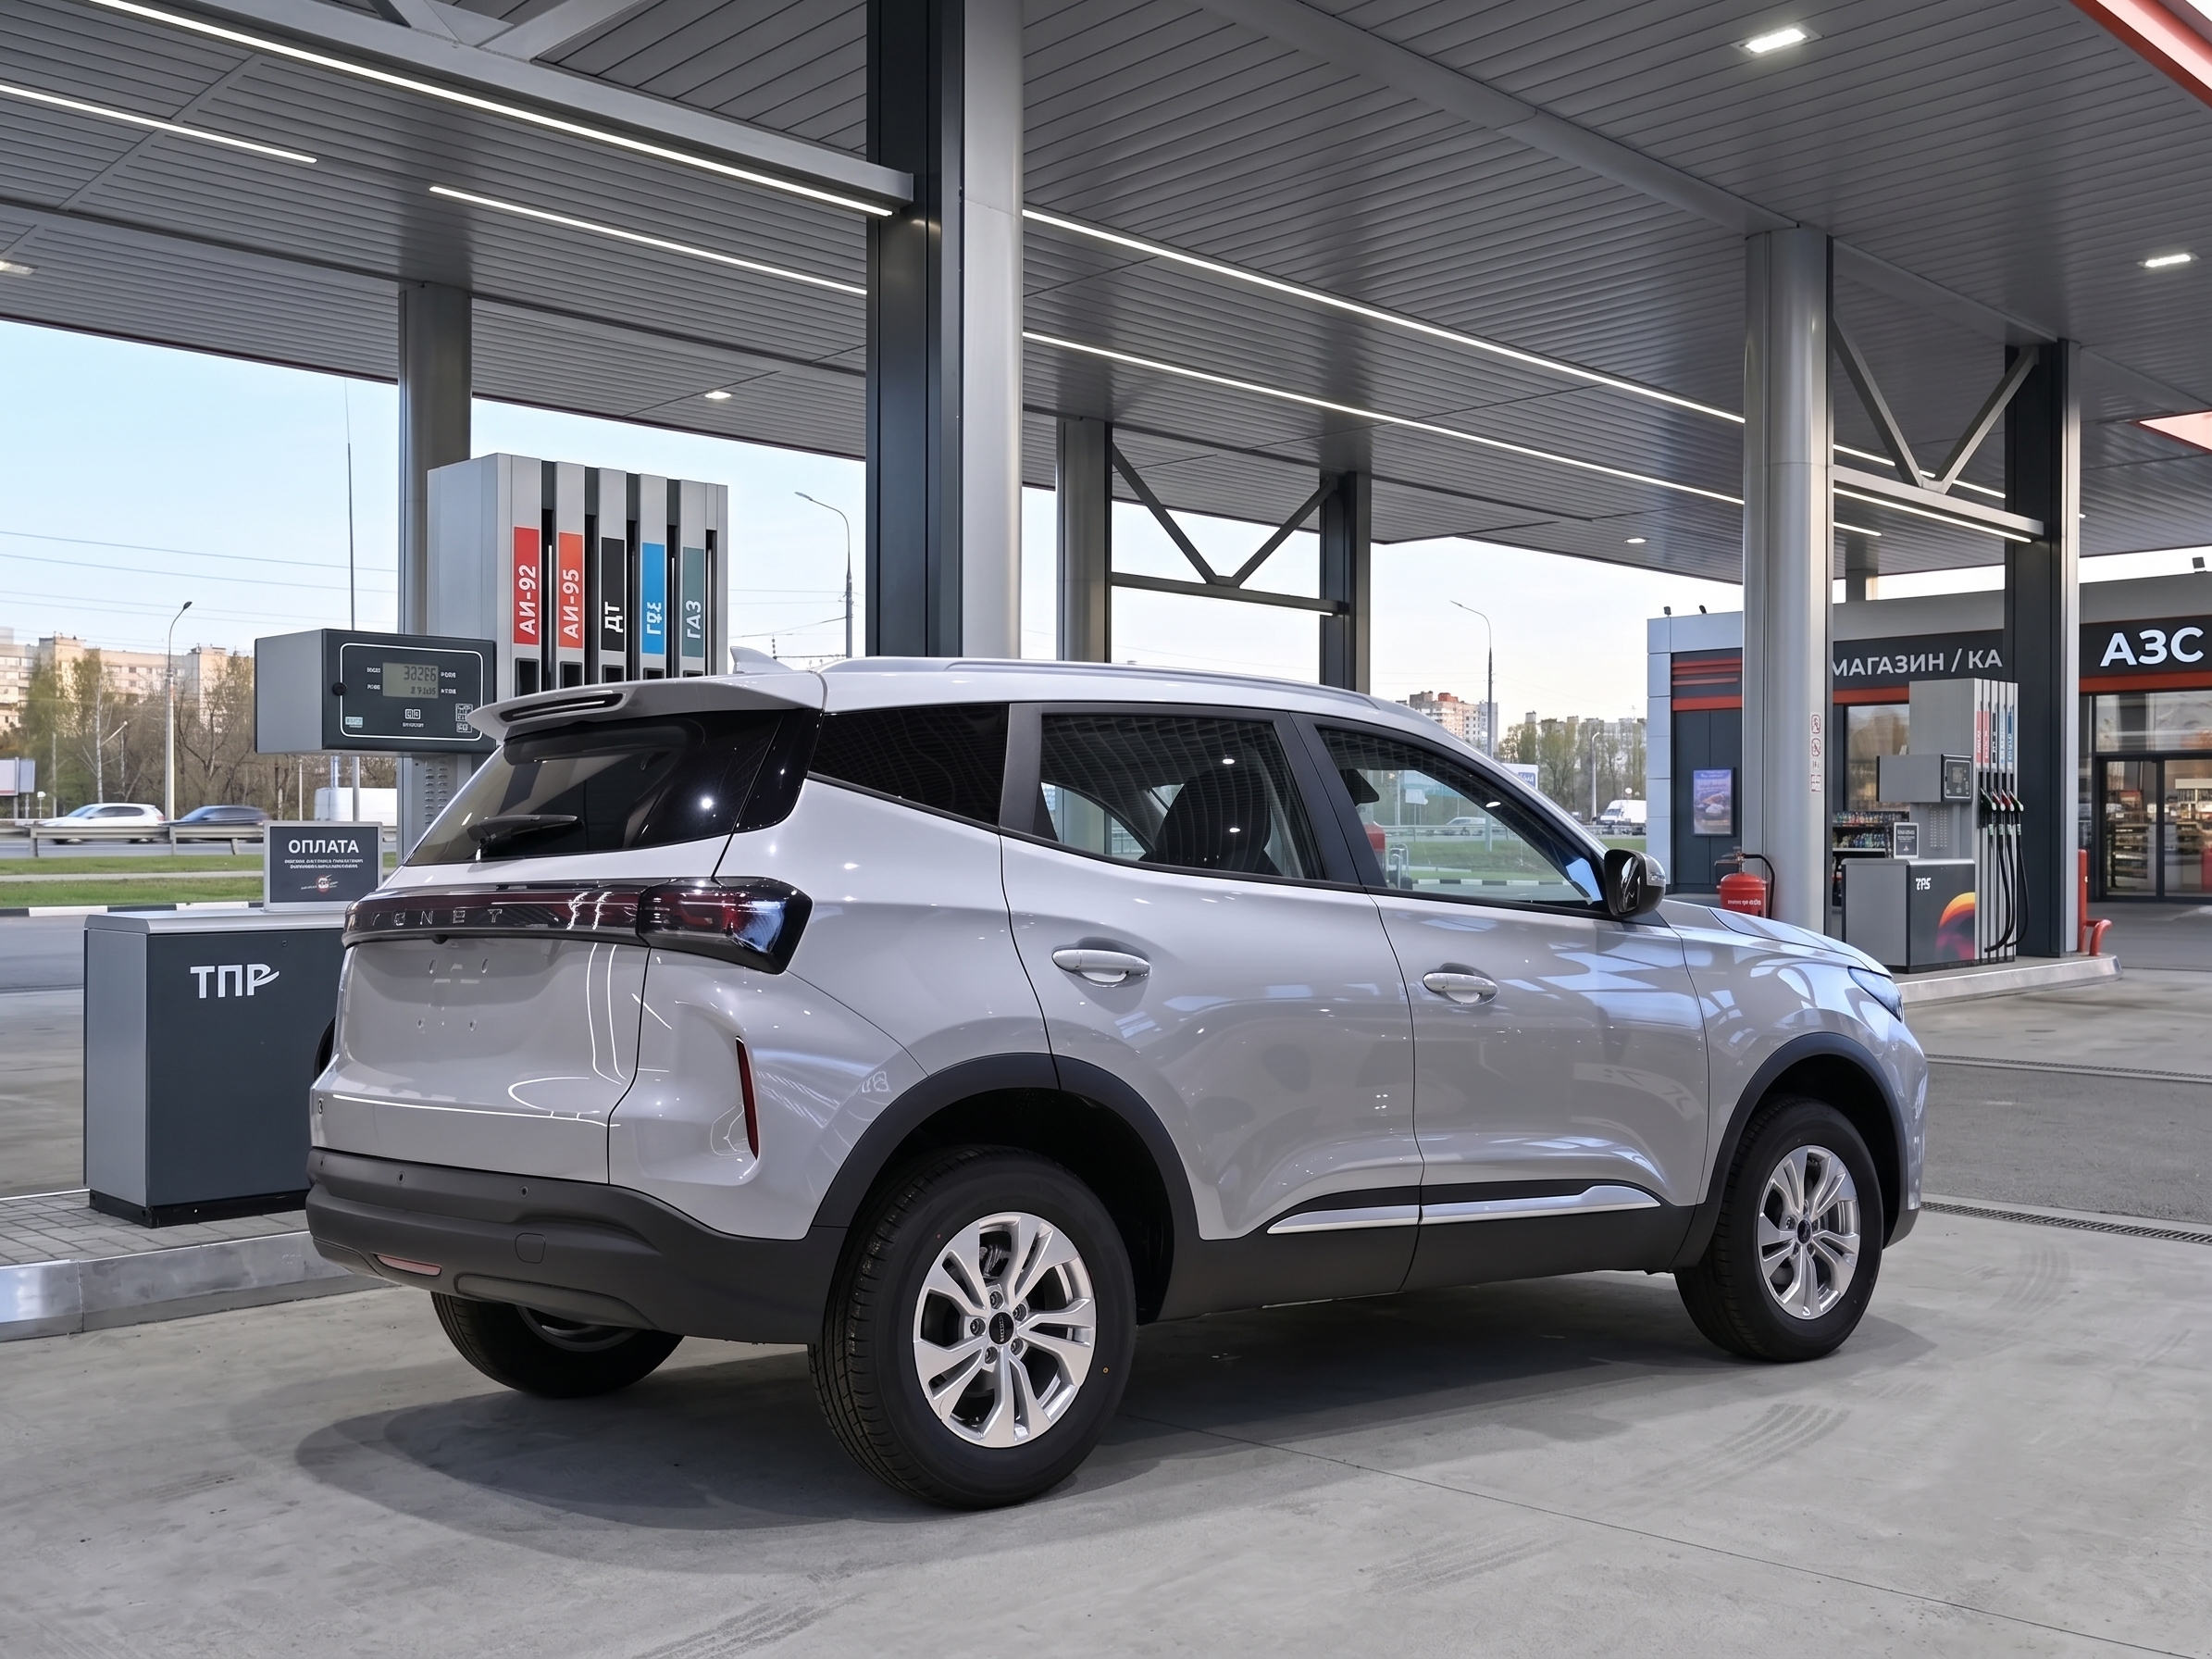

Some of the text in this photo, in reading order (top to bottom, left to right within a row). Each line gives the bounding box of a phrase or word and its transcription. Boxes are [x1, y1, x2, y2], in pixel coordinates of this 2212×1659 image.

[518, 564, 537, 635] АИ-92
[562, 568, 579, 639] АИ-95
[604, 601, 624, 633] ДТ
[685, 600, 702, 639] ГАЗ
[1833, 653, 1945, 677] МАГАЗИН
[1968, 649, 2003, 669] КА
[2099, 626, 2205, 667] АЗС
[288, 839, 360, 854] ОПЛАТА
[190, 963, 280, 999] ТПР
